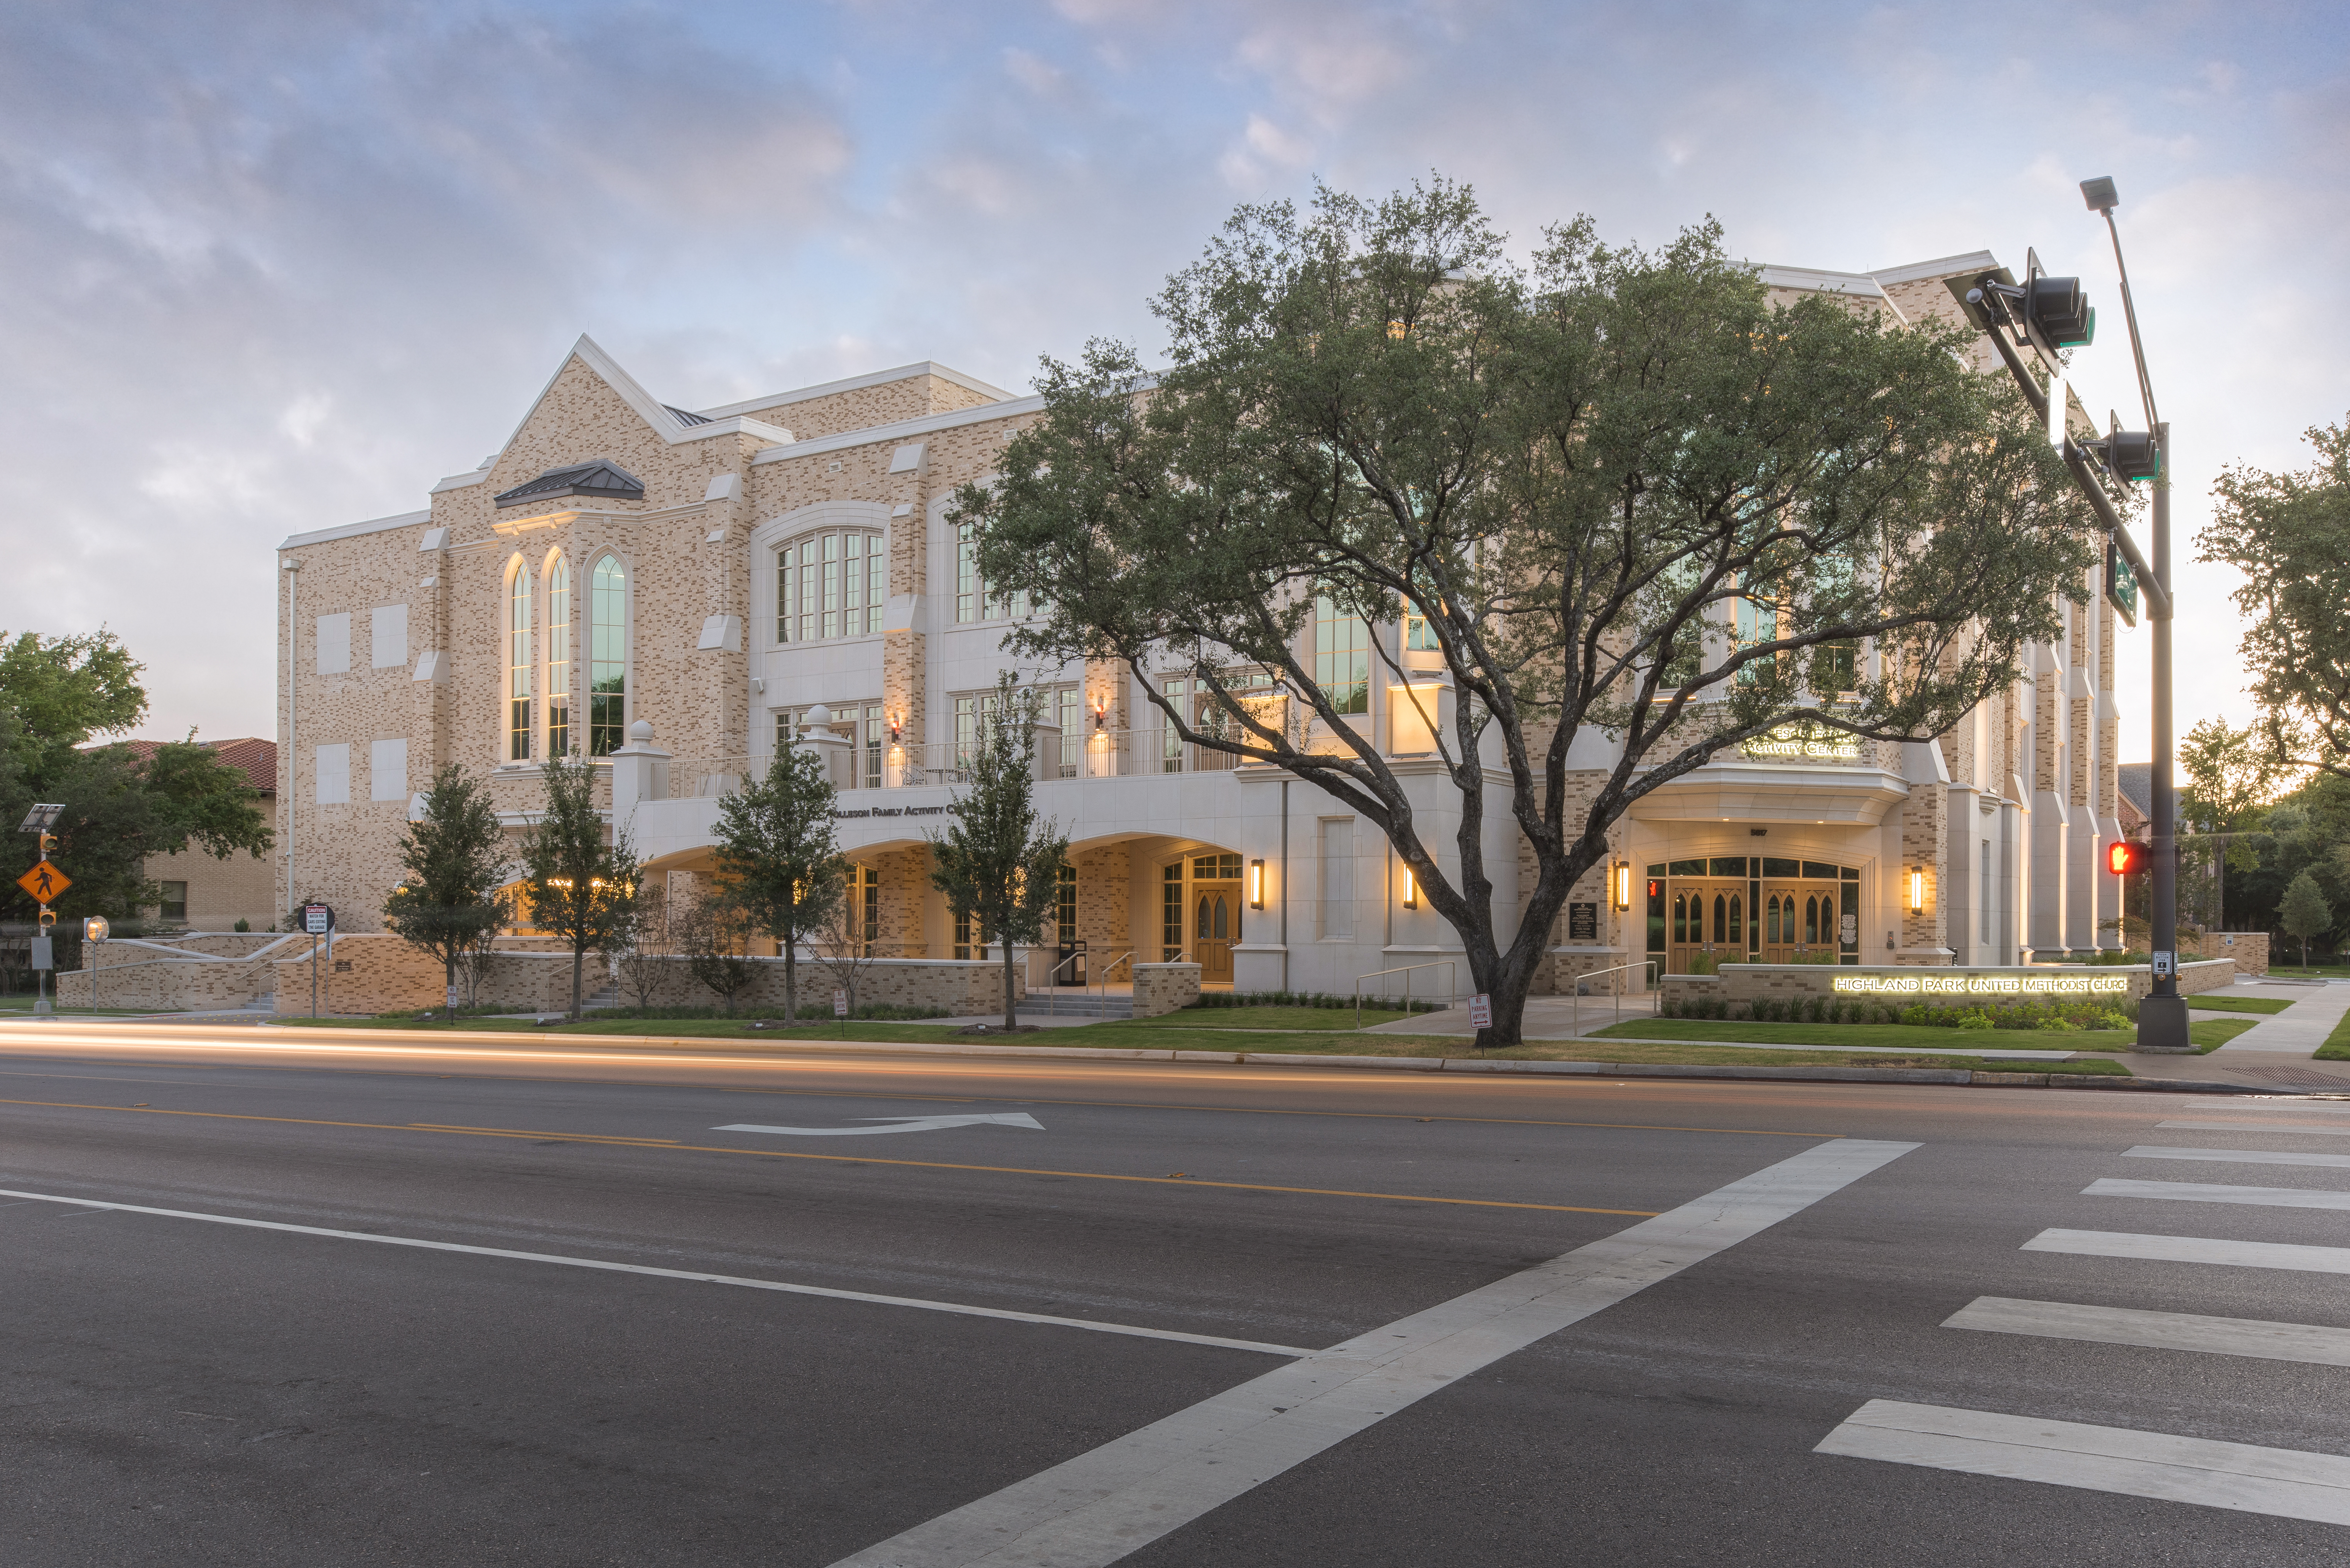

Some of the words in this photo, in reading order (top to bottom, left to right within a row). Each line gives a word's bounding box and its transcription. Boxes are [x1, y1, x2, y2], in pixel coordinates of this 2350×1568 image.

[871, 807, 902, 817] FAMILY
[904, 806, 944, 816] ACTIVITY
[1837, 980, 1919, 990] HIGHLAND
[1925, 980, 1965, 990] PARK
[1971, 980, 2021, 990] UNITED
[2025, 980, 2091, 990] METHODIST
[2094, 980, 2128, 990] CHURCH
